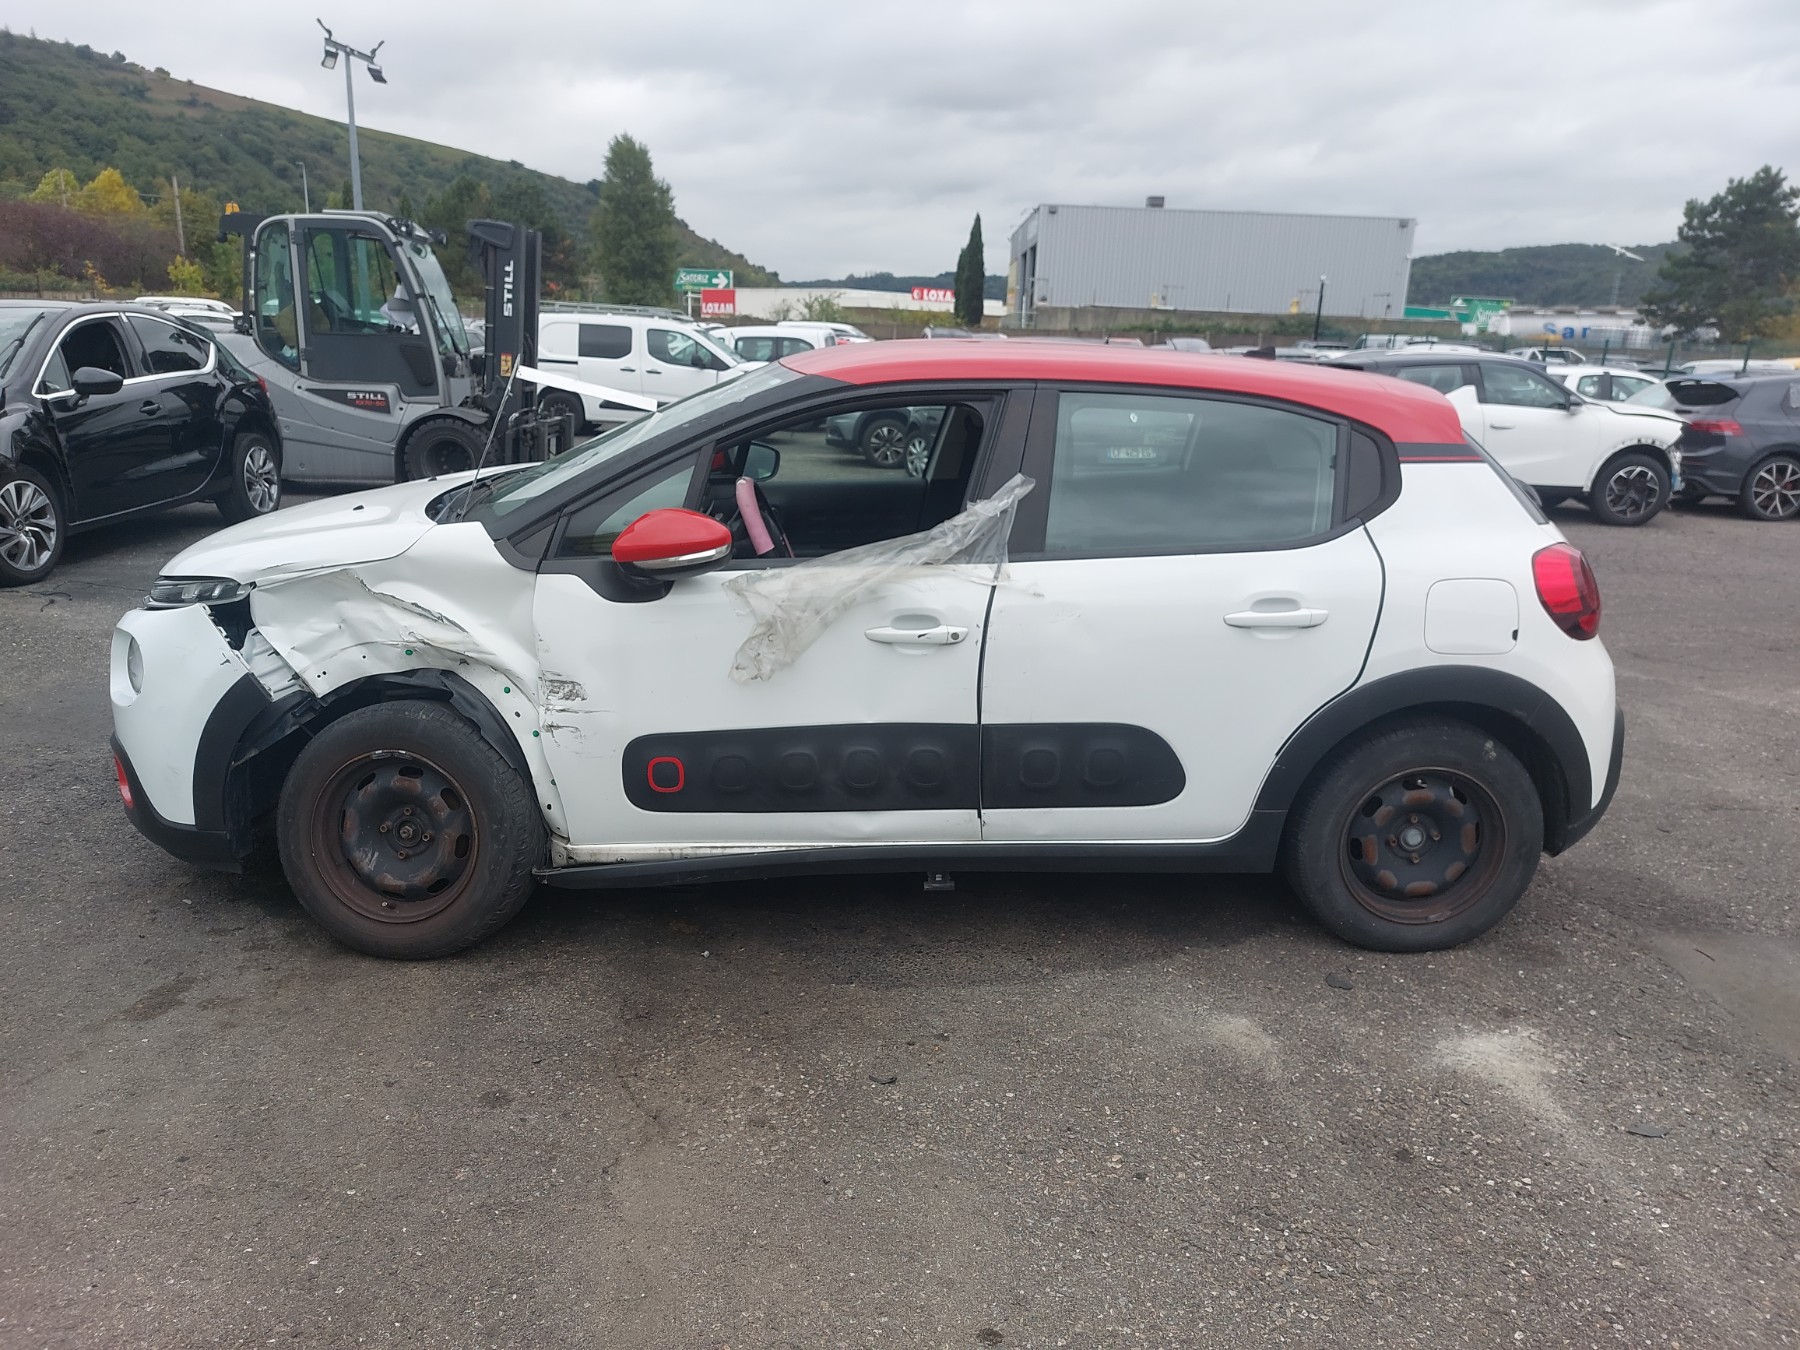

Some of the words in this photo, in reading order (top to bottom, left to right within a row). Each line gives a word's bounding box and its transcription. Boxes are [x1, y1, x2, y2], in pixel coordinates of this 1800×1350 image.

[503, 259, 514, 317] STILL
[923, 288, 956, 302] LOXA
[701, 302, 734, 314] LOXAM
[347, 391, 386, 401] STILL
